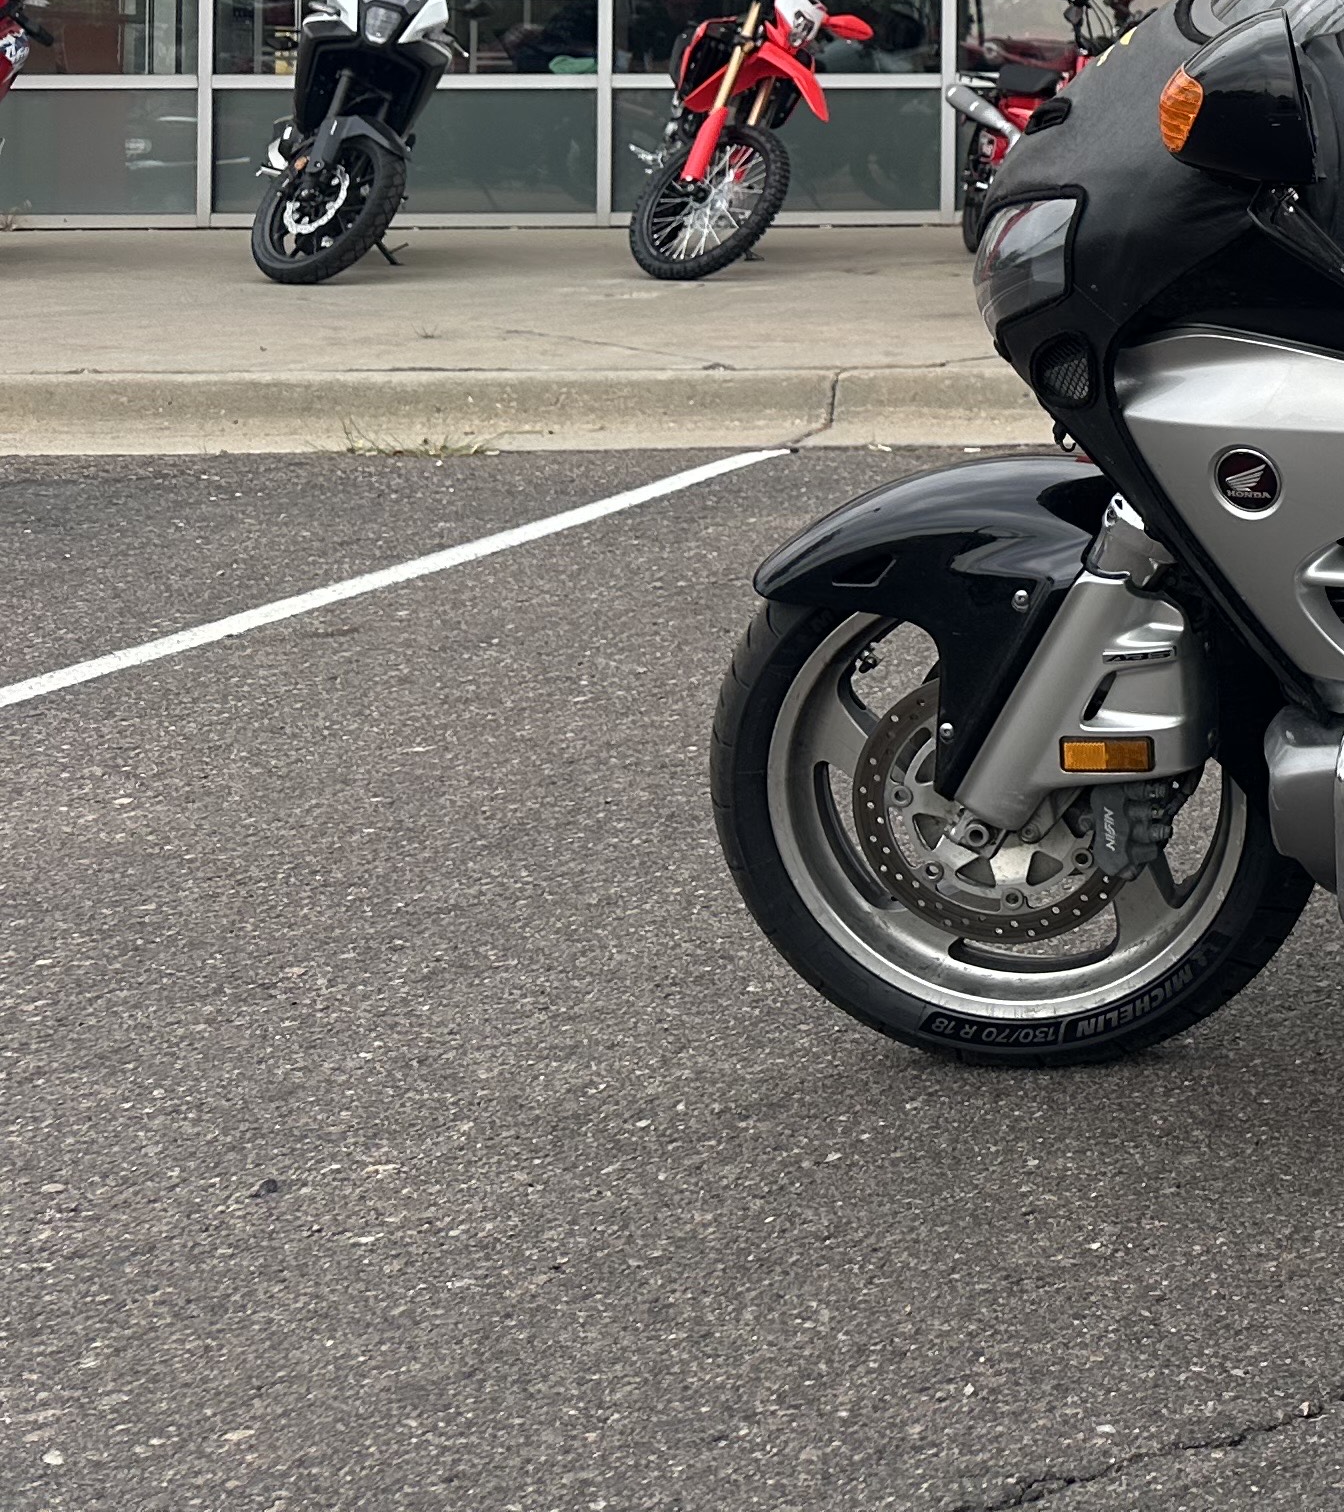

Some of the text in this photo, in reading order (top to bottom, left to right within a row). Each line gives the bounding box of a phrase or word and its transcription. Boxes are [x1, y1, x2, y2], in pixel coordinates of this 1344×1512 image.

[1226, 489, 1272, 499] HONDA
[1075, 963, 1195, 1038] MICHELIN
[931, 1018, 1058, 1043] 130/70 R 18
